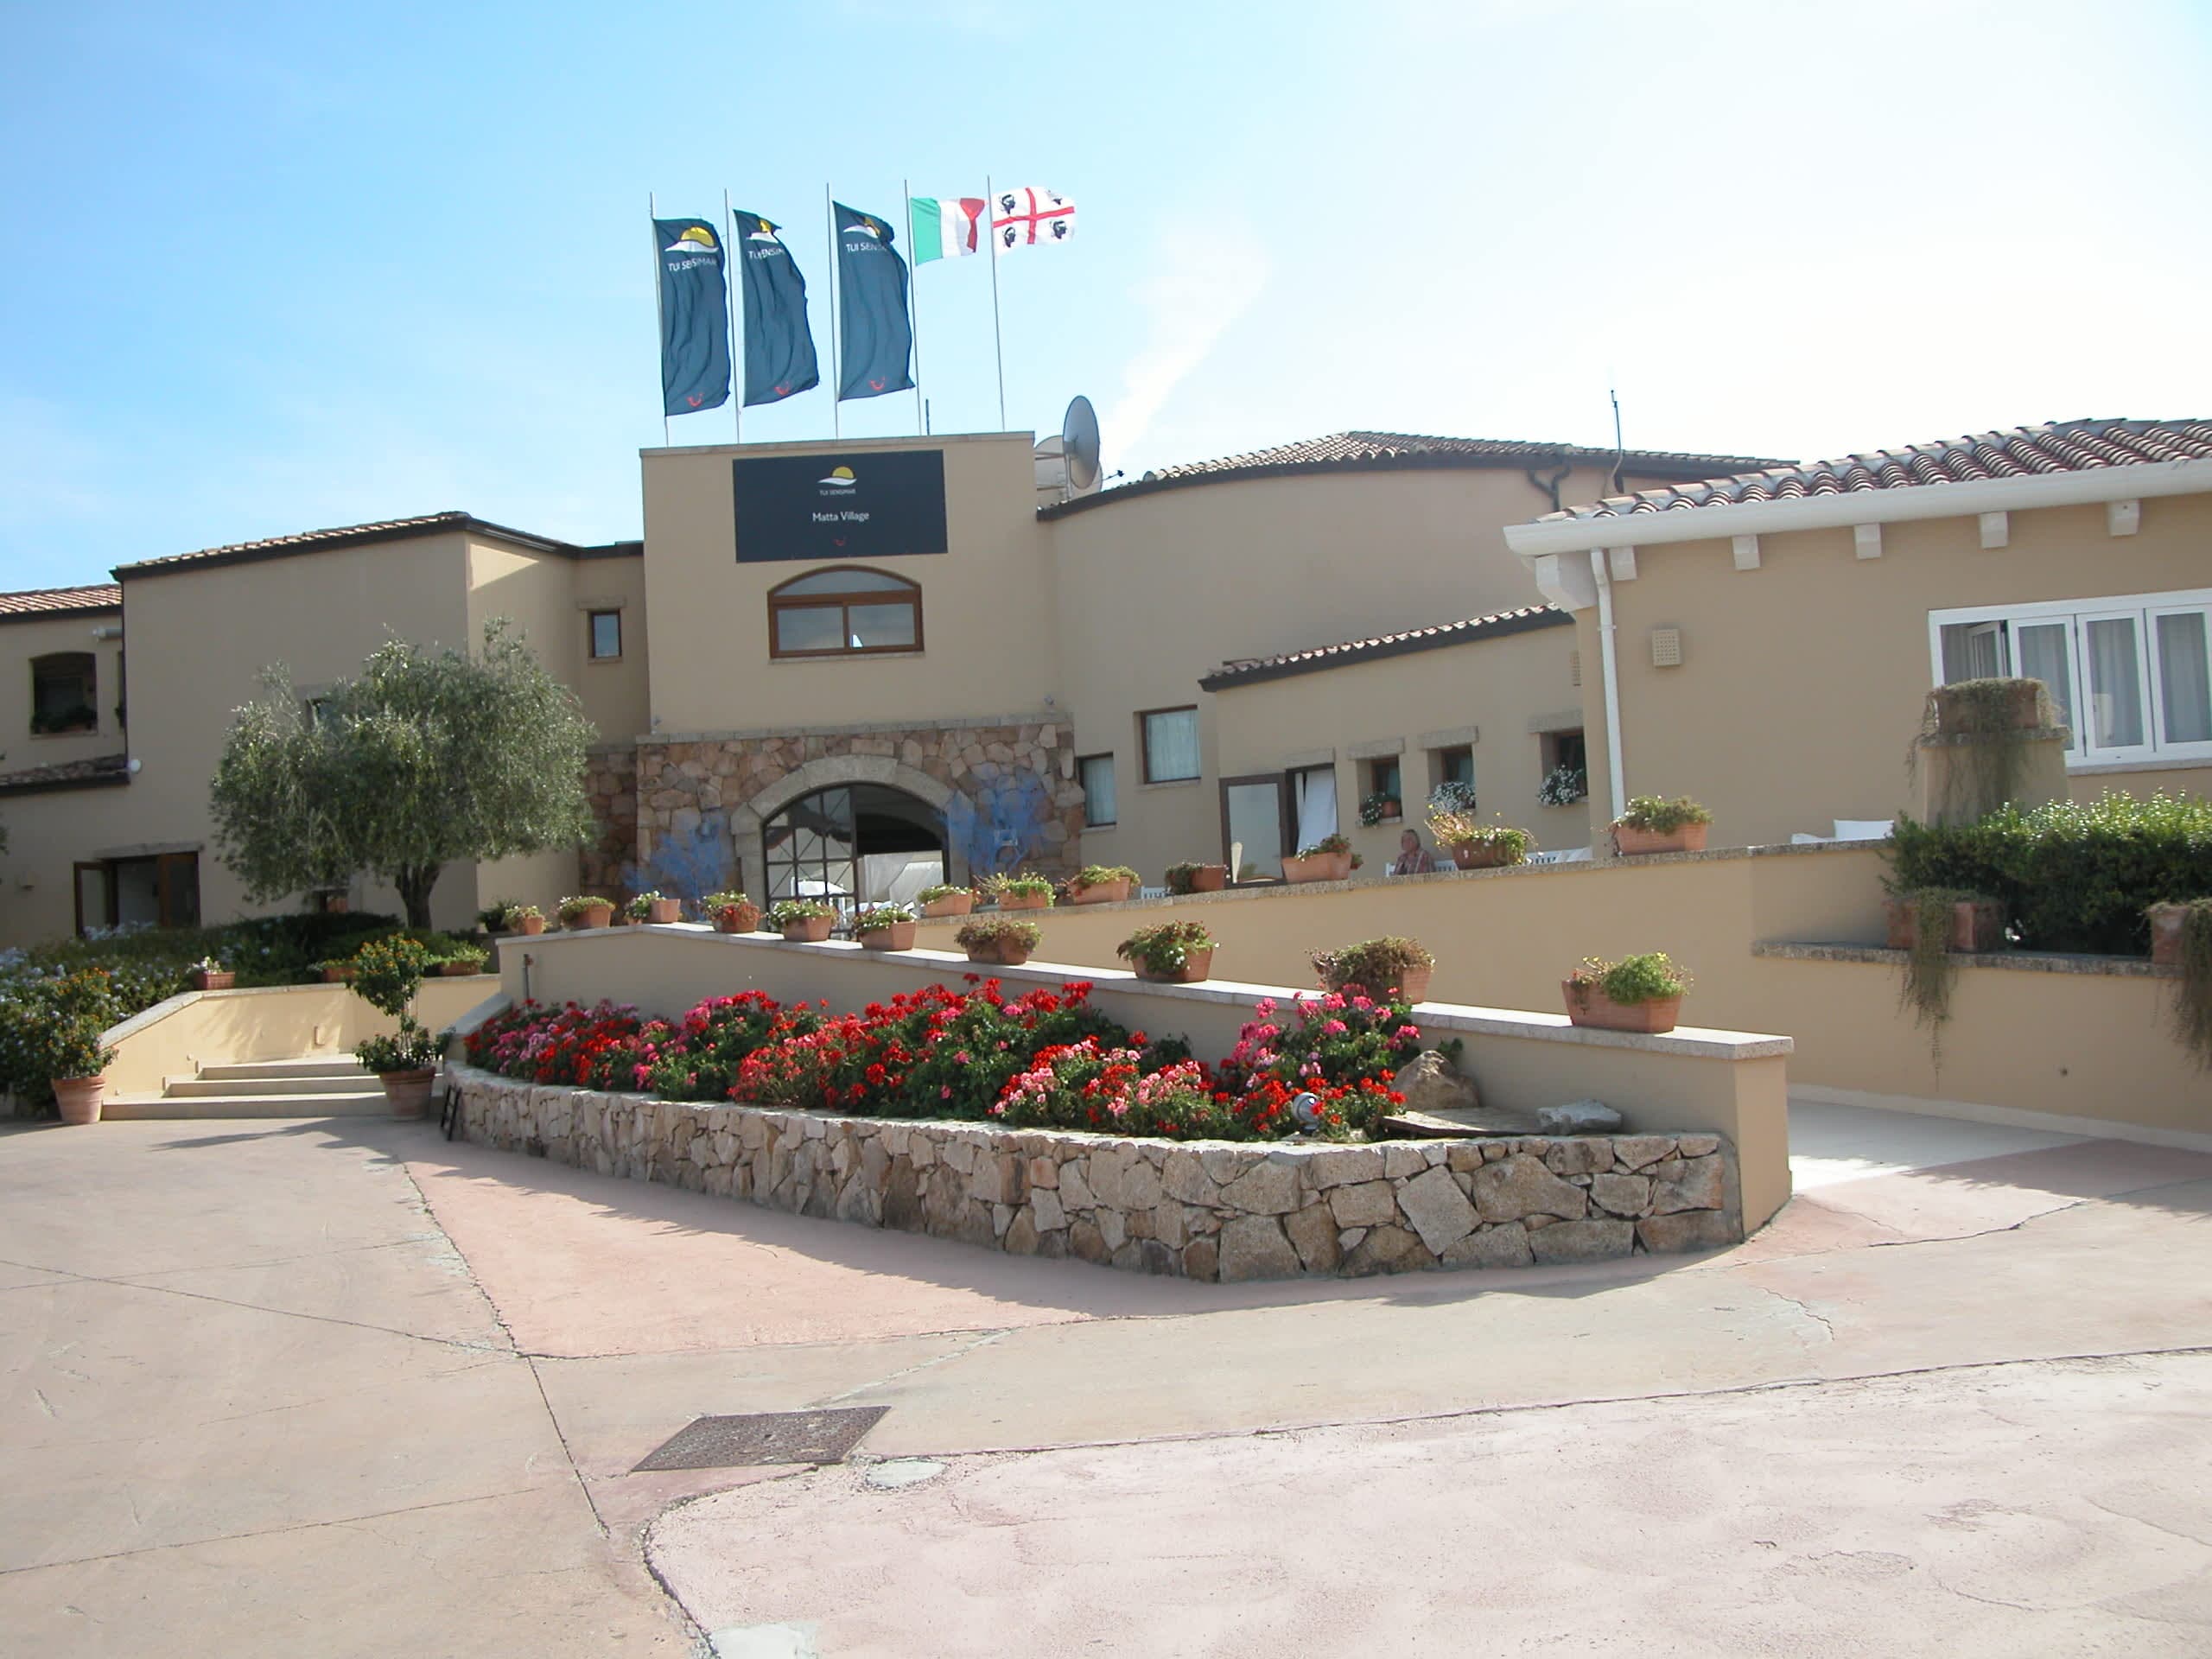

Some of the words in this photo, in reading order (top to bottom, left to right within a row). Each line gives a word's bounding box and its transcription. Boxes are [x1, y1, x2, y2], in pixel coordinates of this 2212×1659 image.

[845, 242, 859, 252] TUI
[668, 262, 680, 272] TUI
[812, 512, 838, 522] Matta
[840, 511, 869, 522] Village
